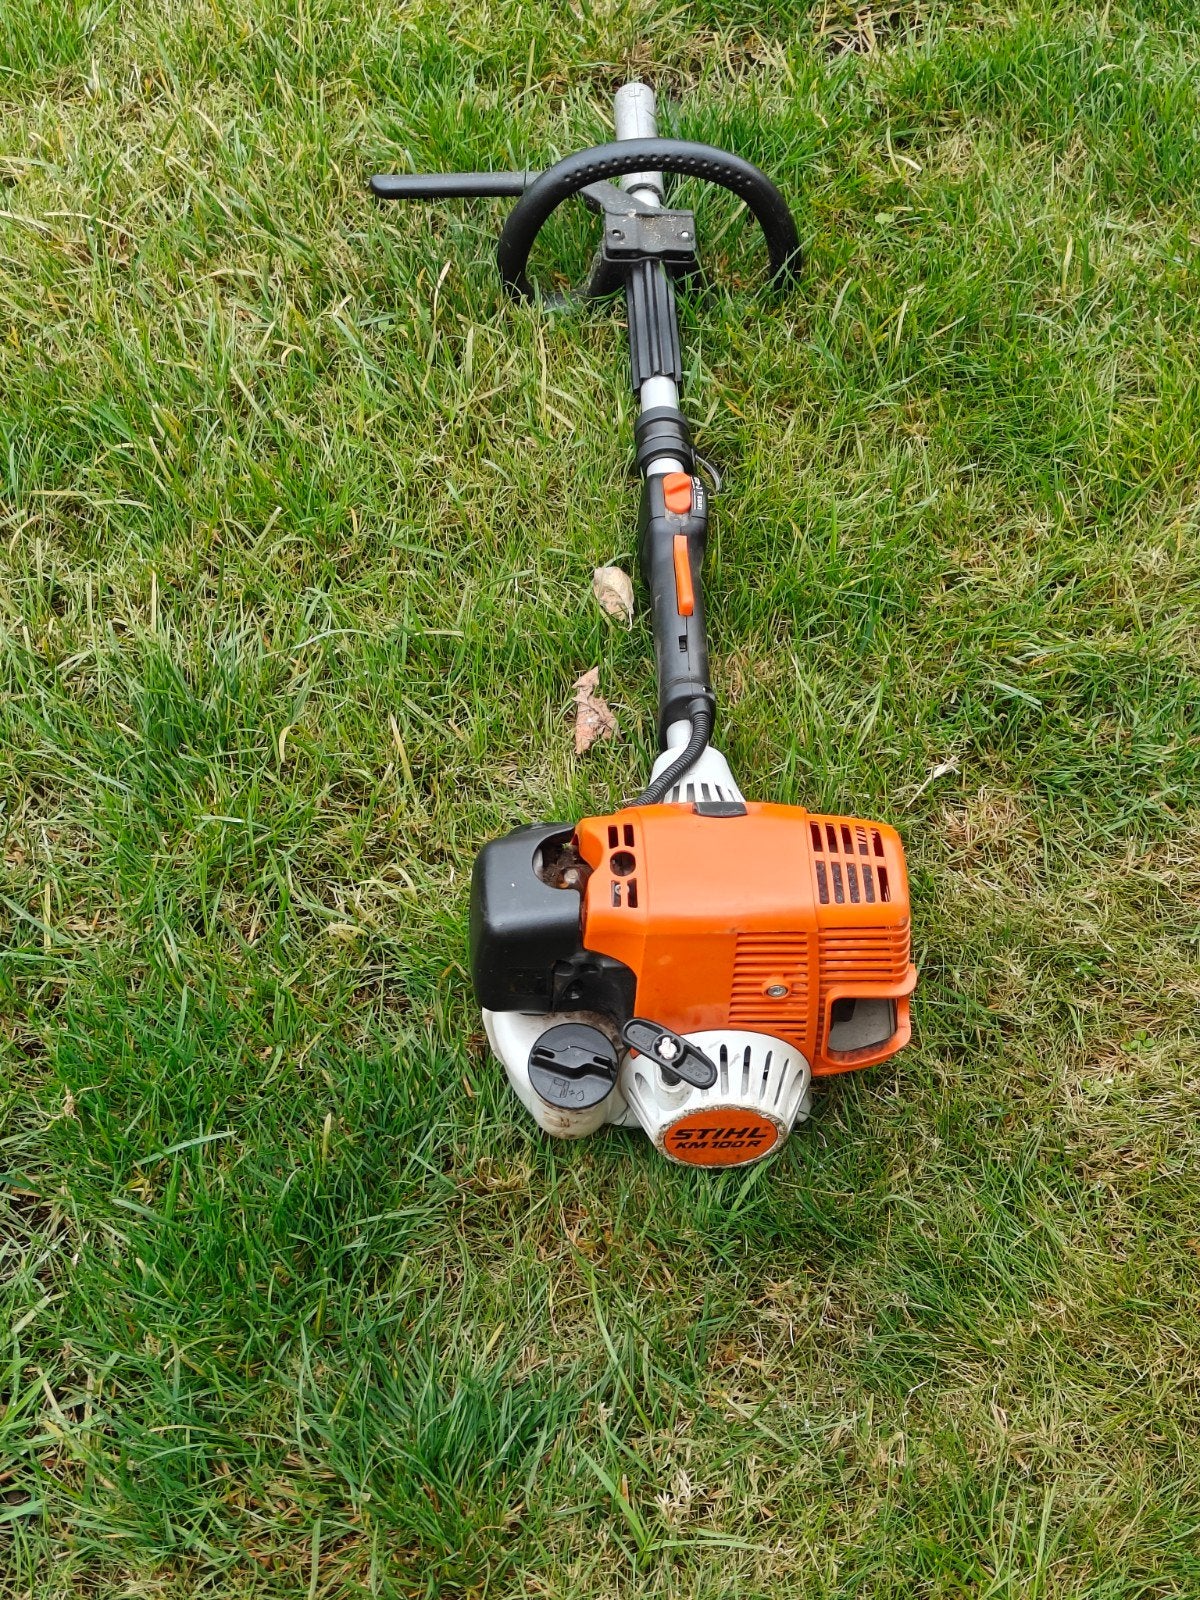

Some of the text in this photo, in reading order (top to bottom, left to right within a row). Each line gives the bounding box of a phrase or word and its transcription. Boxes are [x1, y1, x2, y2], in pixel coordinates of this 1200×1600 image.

[671, 1127, 767, 1140] STIHL
[675, 1140, 761, 1149] KM 100 R
